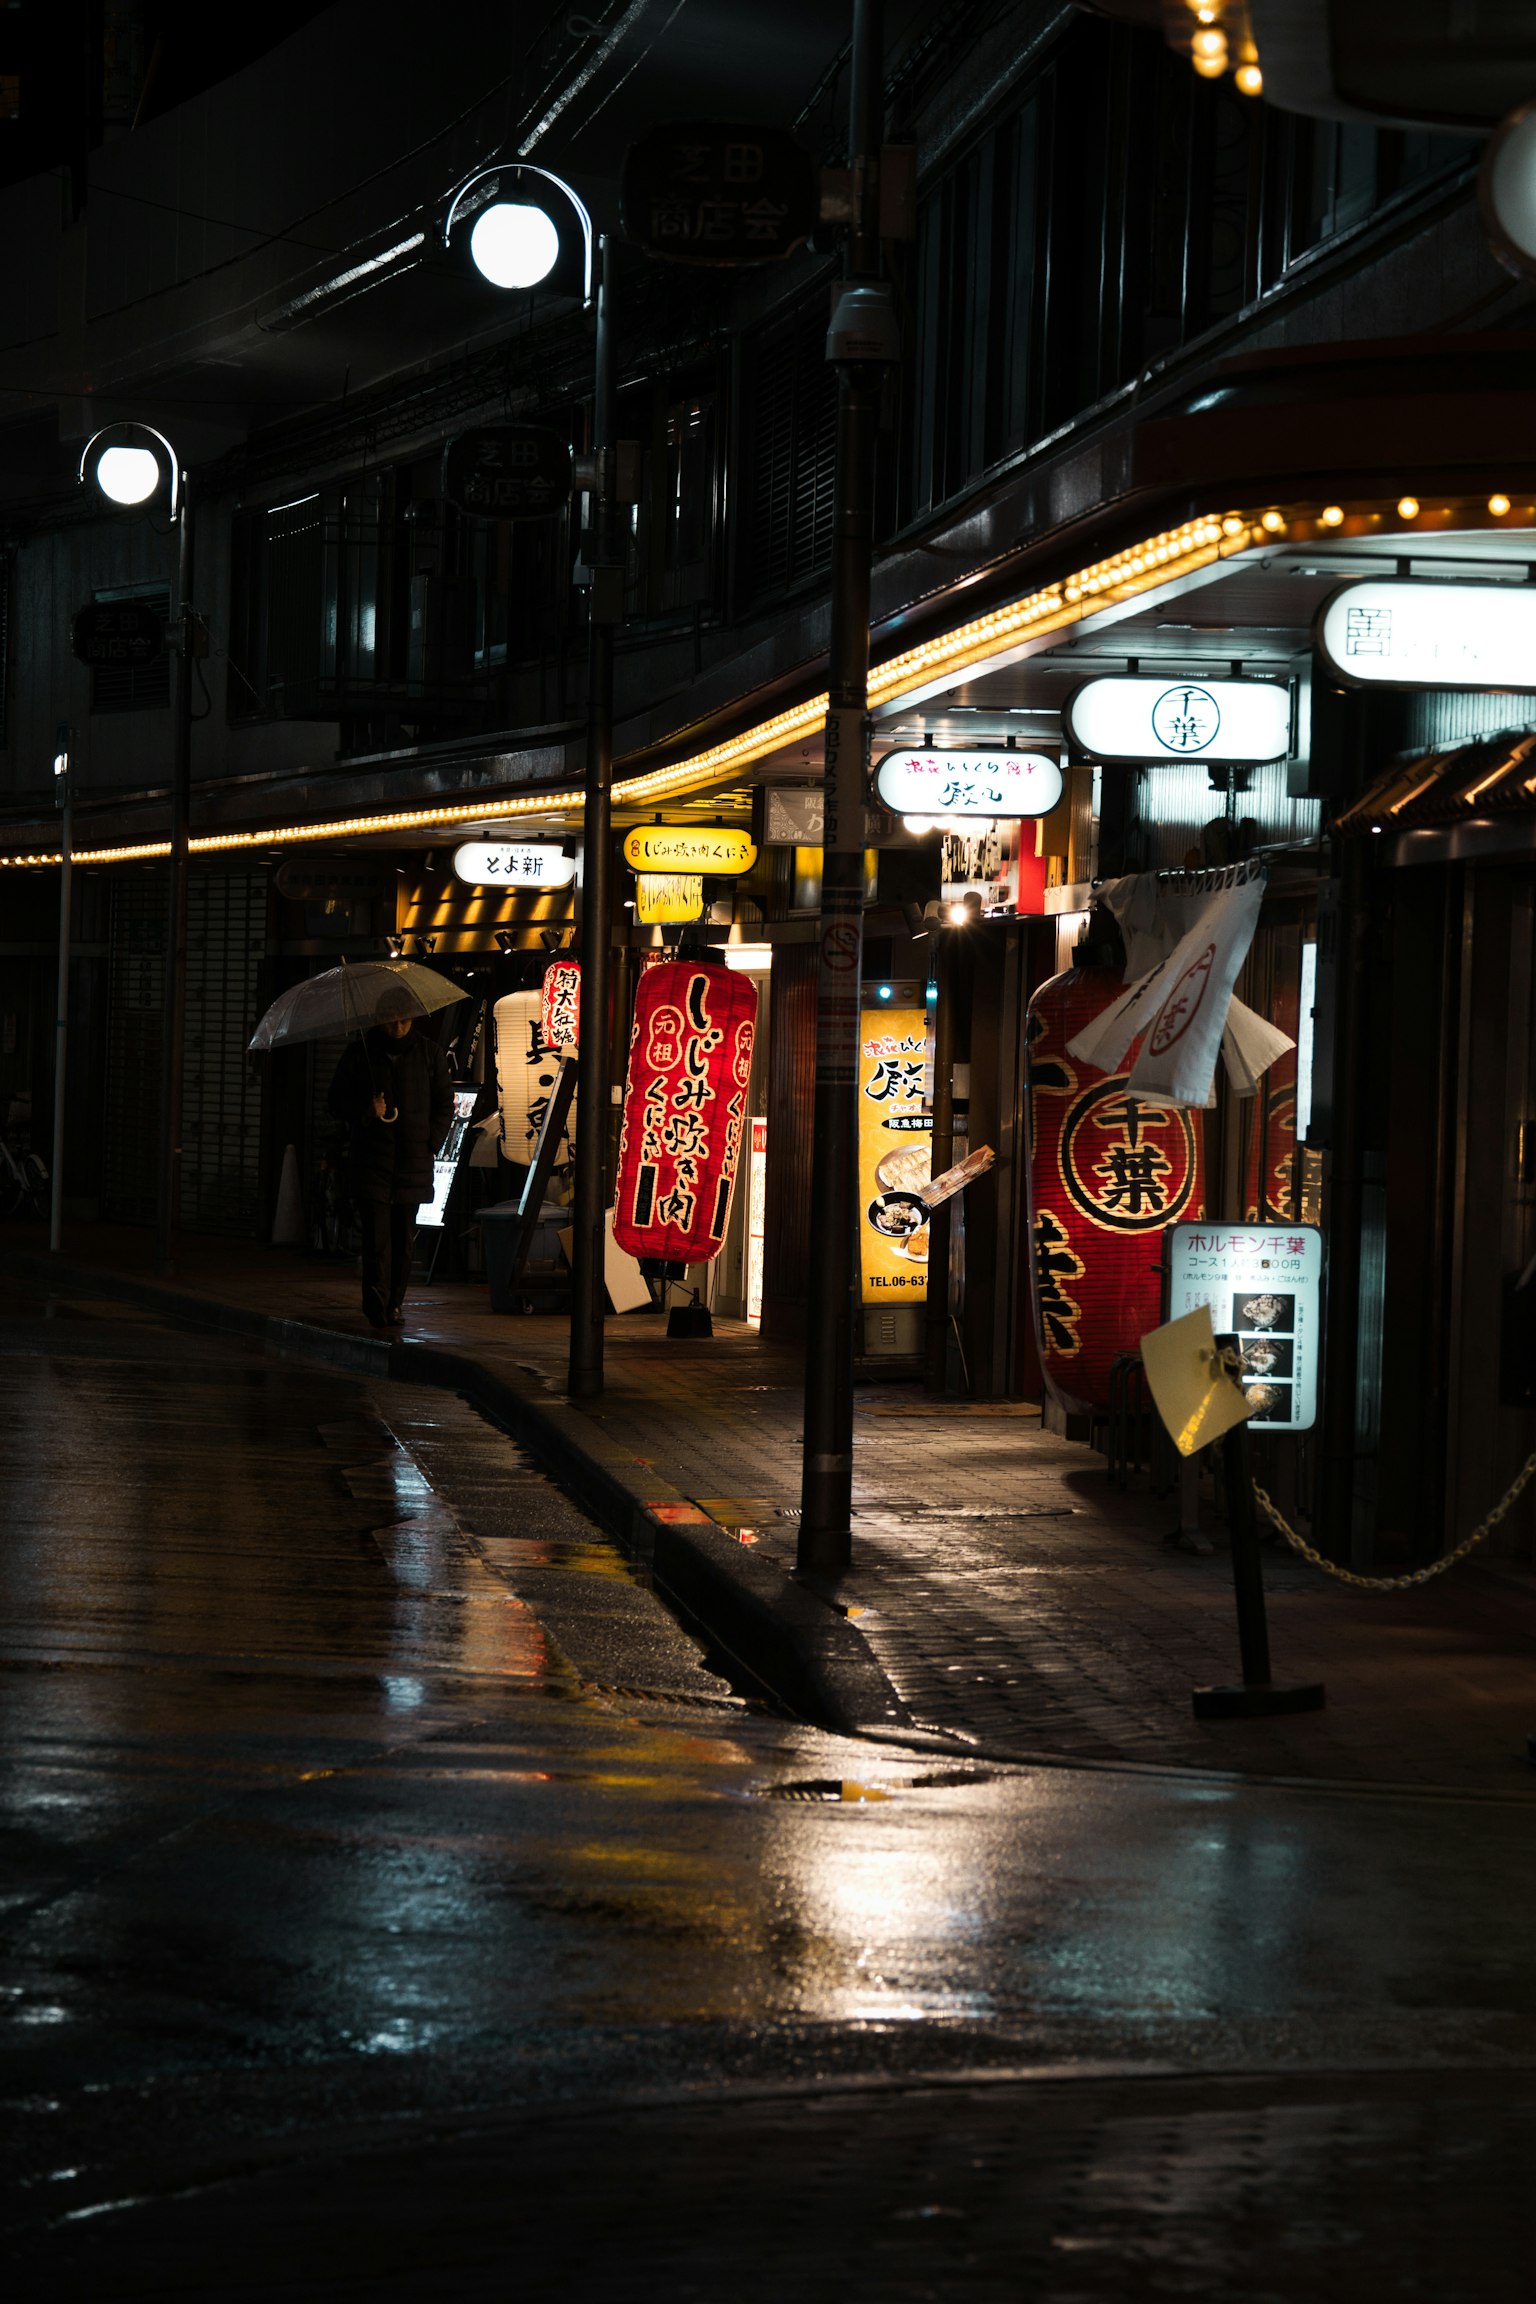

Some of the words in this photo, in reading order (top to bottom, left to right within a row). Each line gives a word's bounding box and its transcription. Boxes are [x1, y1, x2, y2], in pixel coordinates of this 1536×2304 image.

[667, 142, 766, 184] 芝田
[649, 191, 790, 241] 商店会
[474, 439, 540, 468] 芝田
[463, 472, 557, 507] 商店会
[1162, 689, 1209, 748] 千葉
[486, 855, 544, 877] とよ新
[650, 1011, 679, 1066] 元祖
[657, 974, 723, 1232] しじみ炊き肉
[890, 1104, 921, 1112] チャオ
[1093, 1097, 1173, 1215] 千葉
[1187, 1233, 1307, 1256] ホルモン千葉
